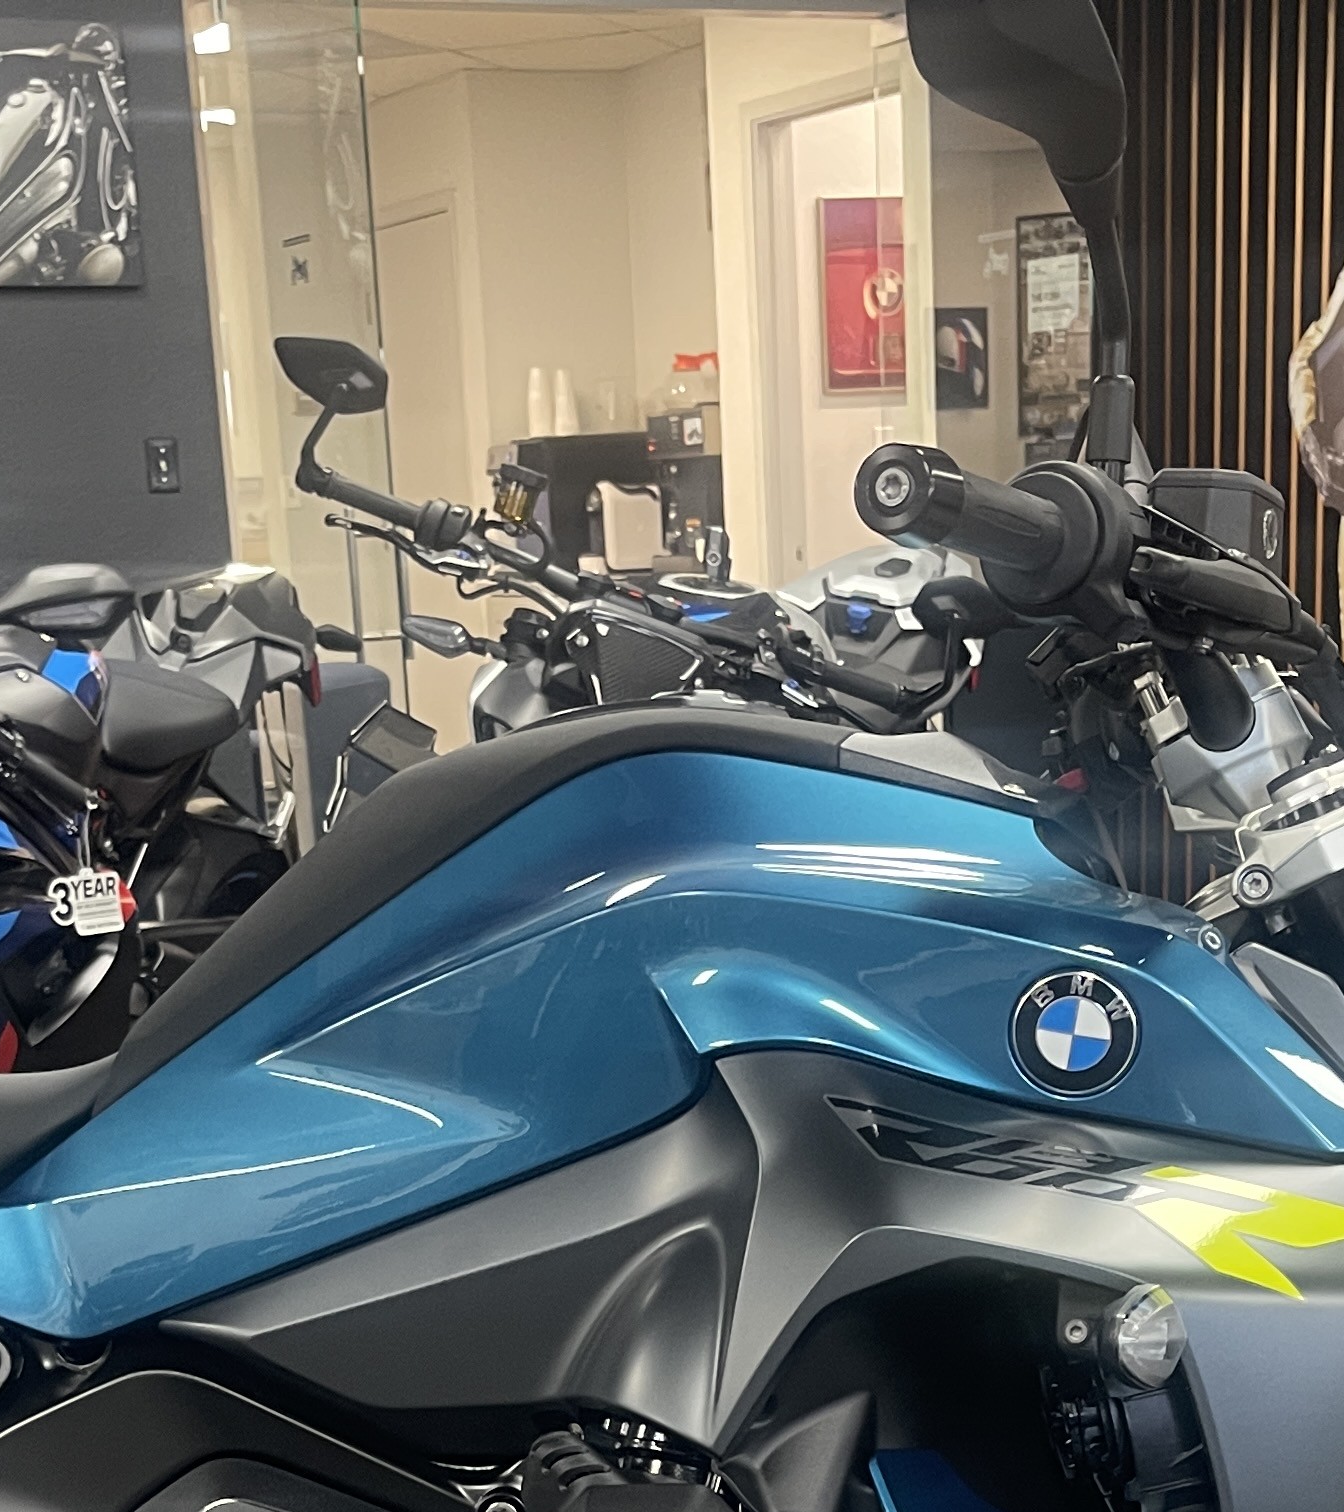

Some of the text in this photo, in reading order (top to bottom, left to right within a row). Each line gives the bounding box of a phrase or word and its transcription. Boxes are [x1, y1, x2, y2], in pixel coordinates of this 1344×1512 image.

[52, 882, 74, 923] 3
[70, 876, 117, 900] YEAR
[1031, 974, 1131, 1022] BMW
